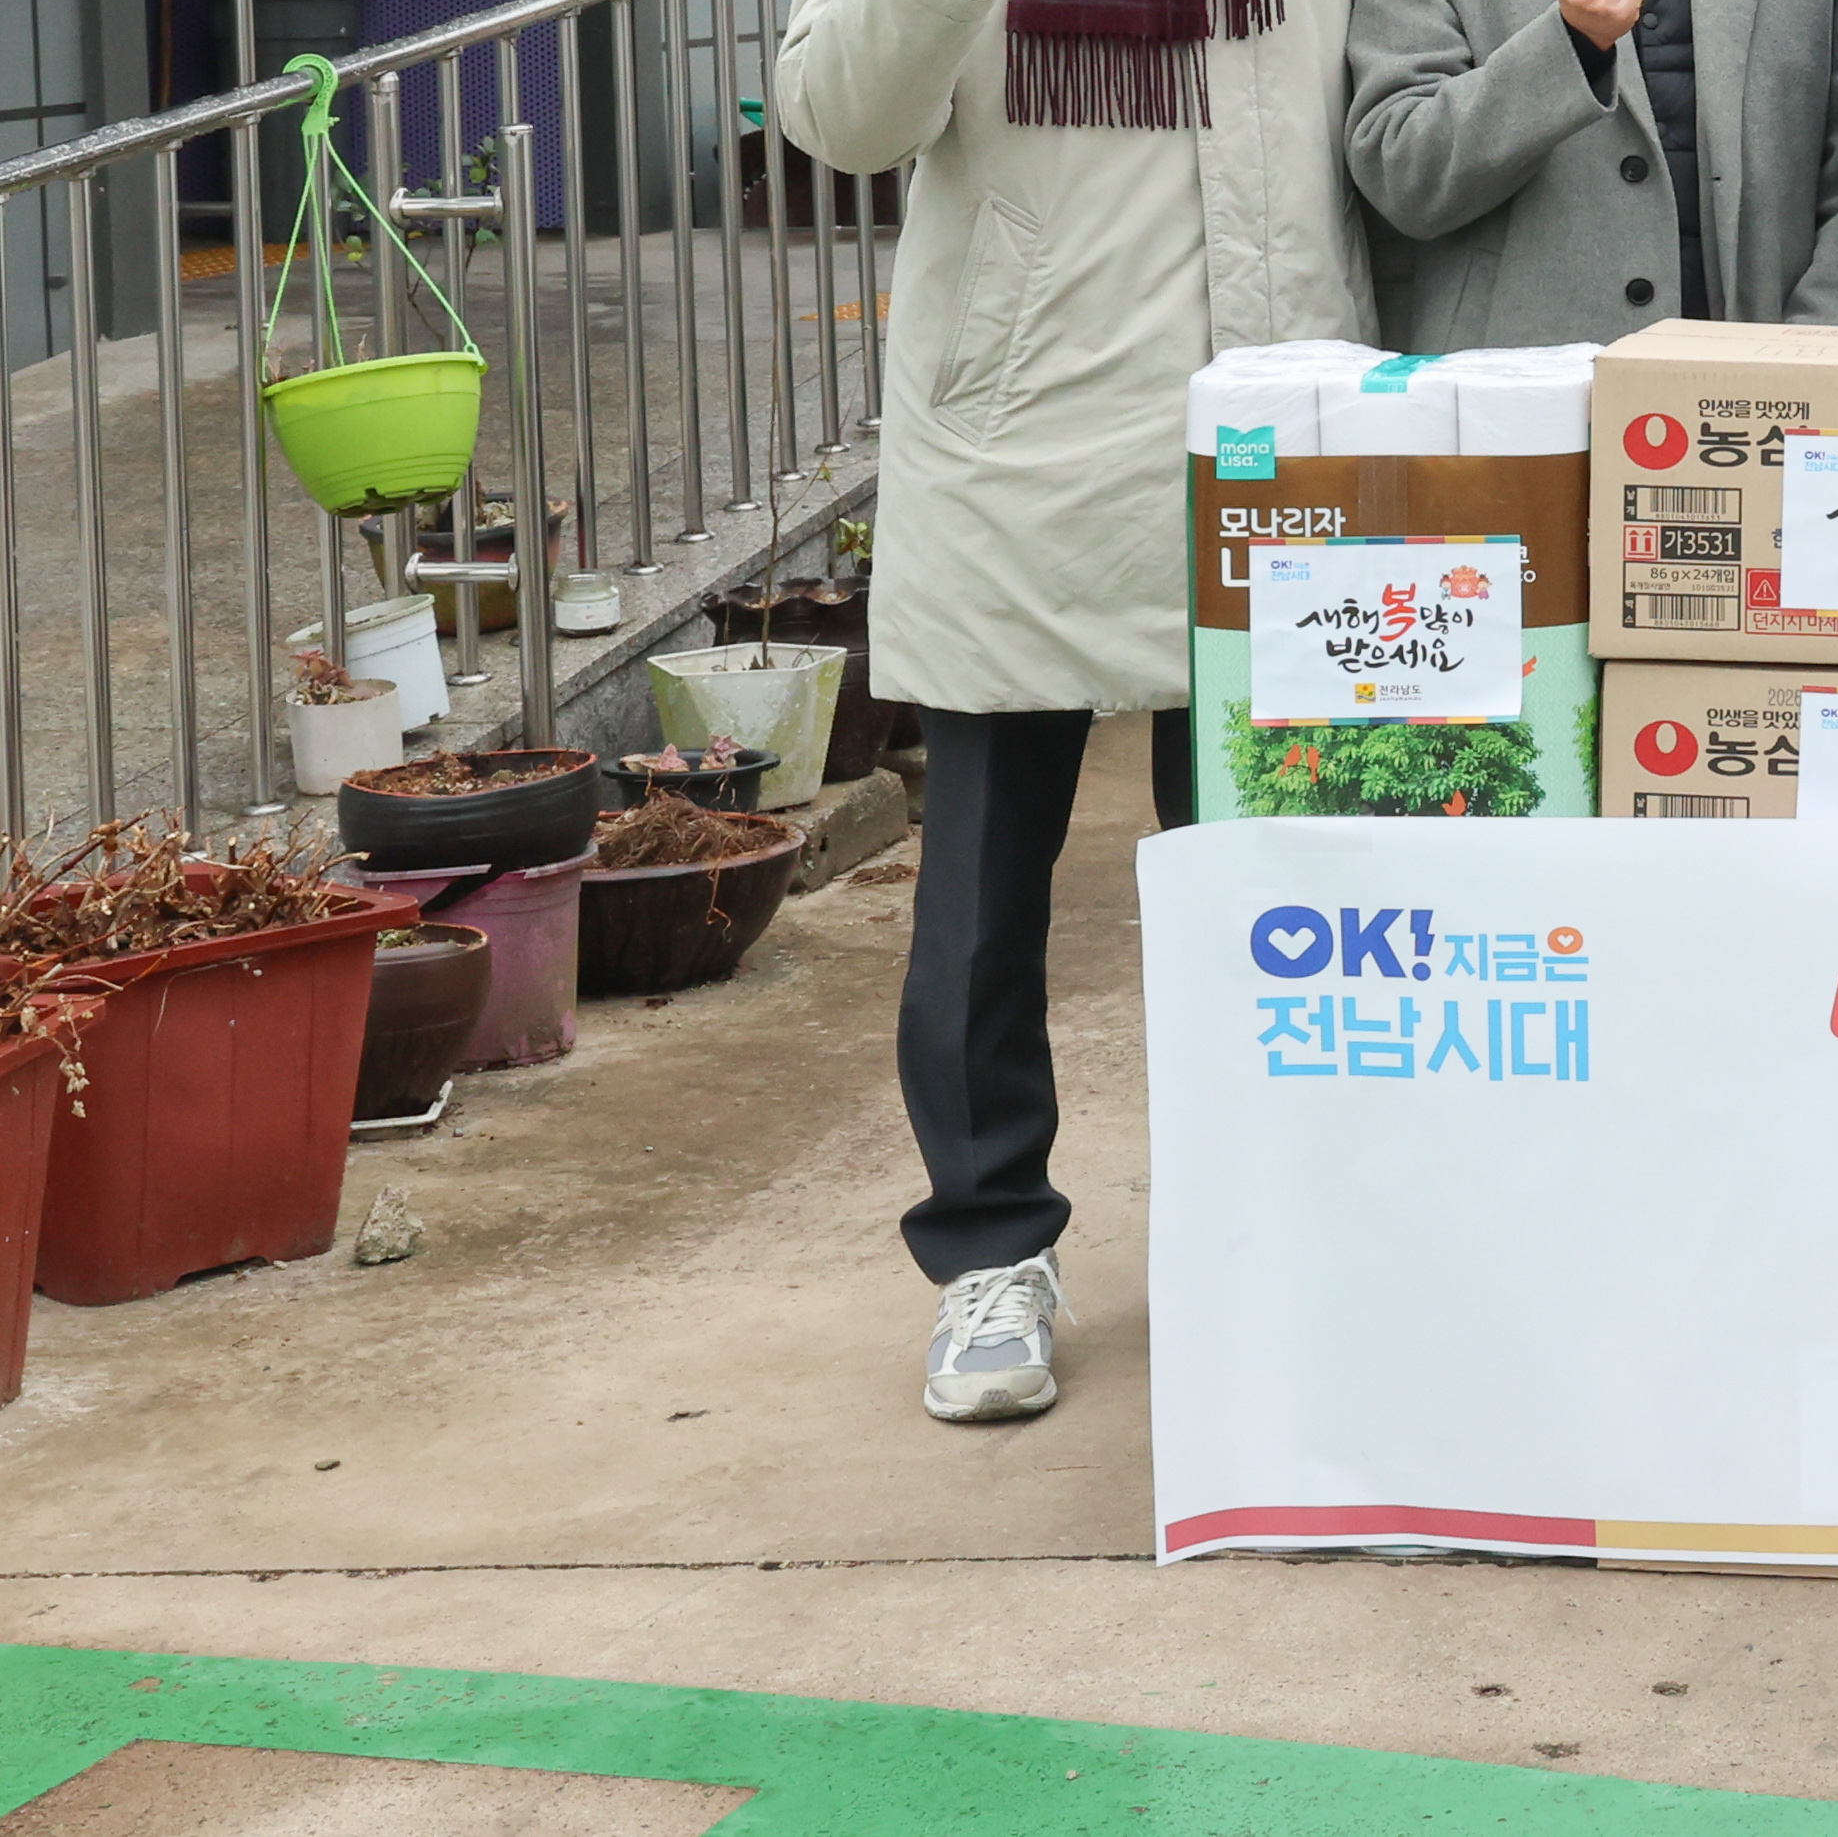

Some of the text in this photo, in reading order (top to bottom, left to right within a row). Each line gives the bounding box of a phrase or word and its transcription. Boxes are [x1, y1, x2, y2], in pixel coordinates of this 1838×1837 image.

[1698, 398, 1810, 420] 인생을 맛있게
[1220, 443, 1270, 455] mona
[1219, 507, 1347, 538] 모나리자
[1664, 531, 1735, 556] 가3531
[1753, 612, 1802, 631] 던지지
[1326, 636, 1464, 673] 받으세요
[1379, 684, 1422, 696] 전라남도
[1706, 708, 1800, 730] 인생을 맛있
[1250, 906, 1590, 982] OK! 지금은
[1255, 995, 1590, 1082] 전남시대
